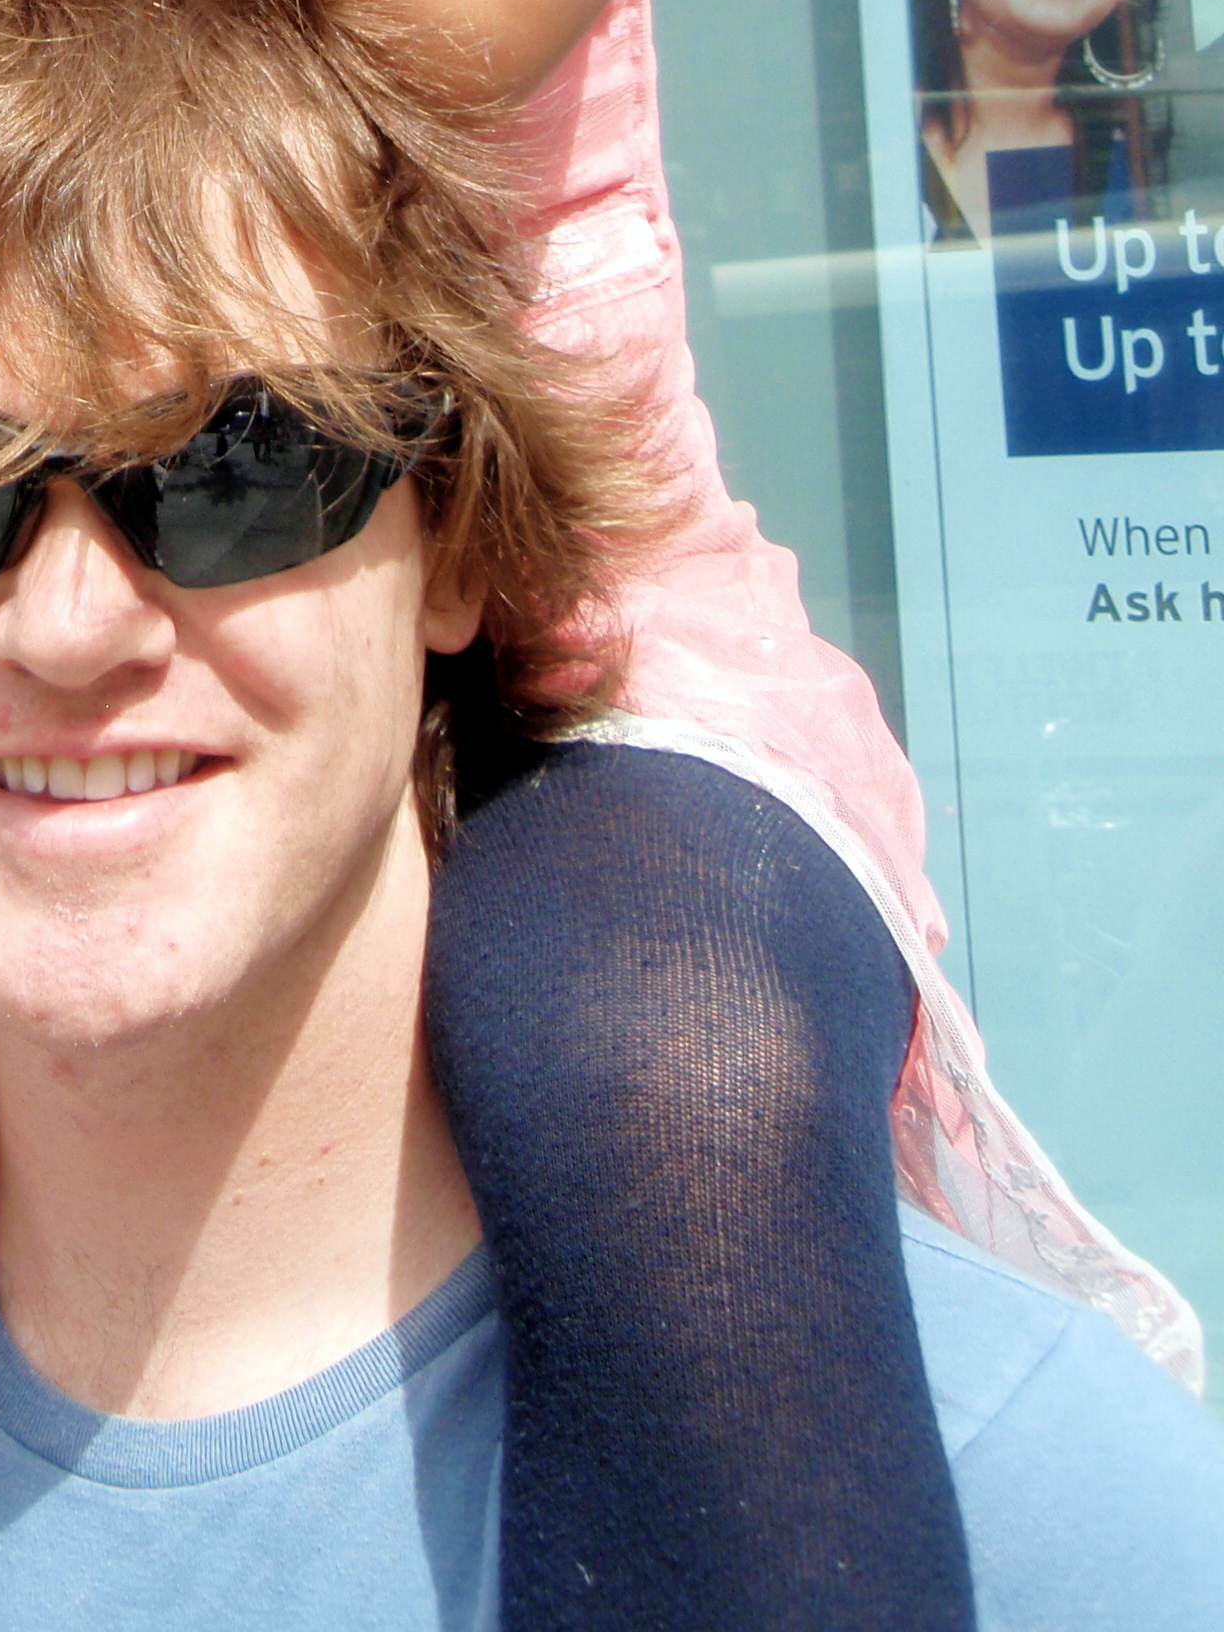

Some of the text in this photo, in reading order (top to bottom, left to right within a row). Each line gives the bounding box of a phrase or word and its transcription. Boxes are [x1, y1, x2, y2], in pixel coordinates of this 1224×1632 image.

[1056, 216, 1157, 294] Up
[1063, 309, 1224, 394] Up t
[1078, 516, 1210, 557] When
[1086, 581, 1183, 623] Ask
